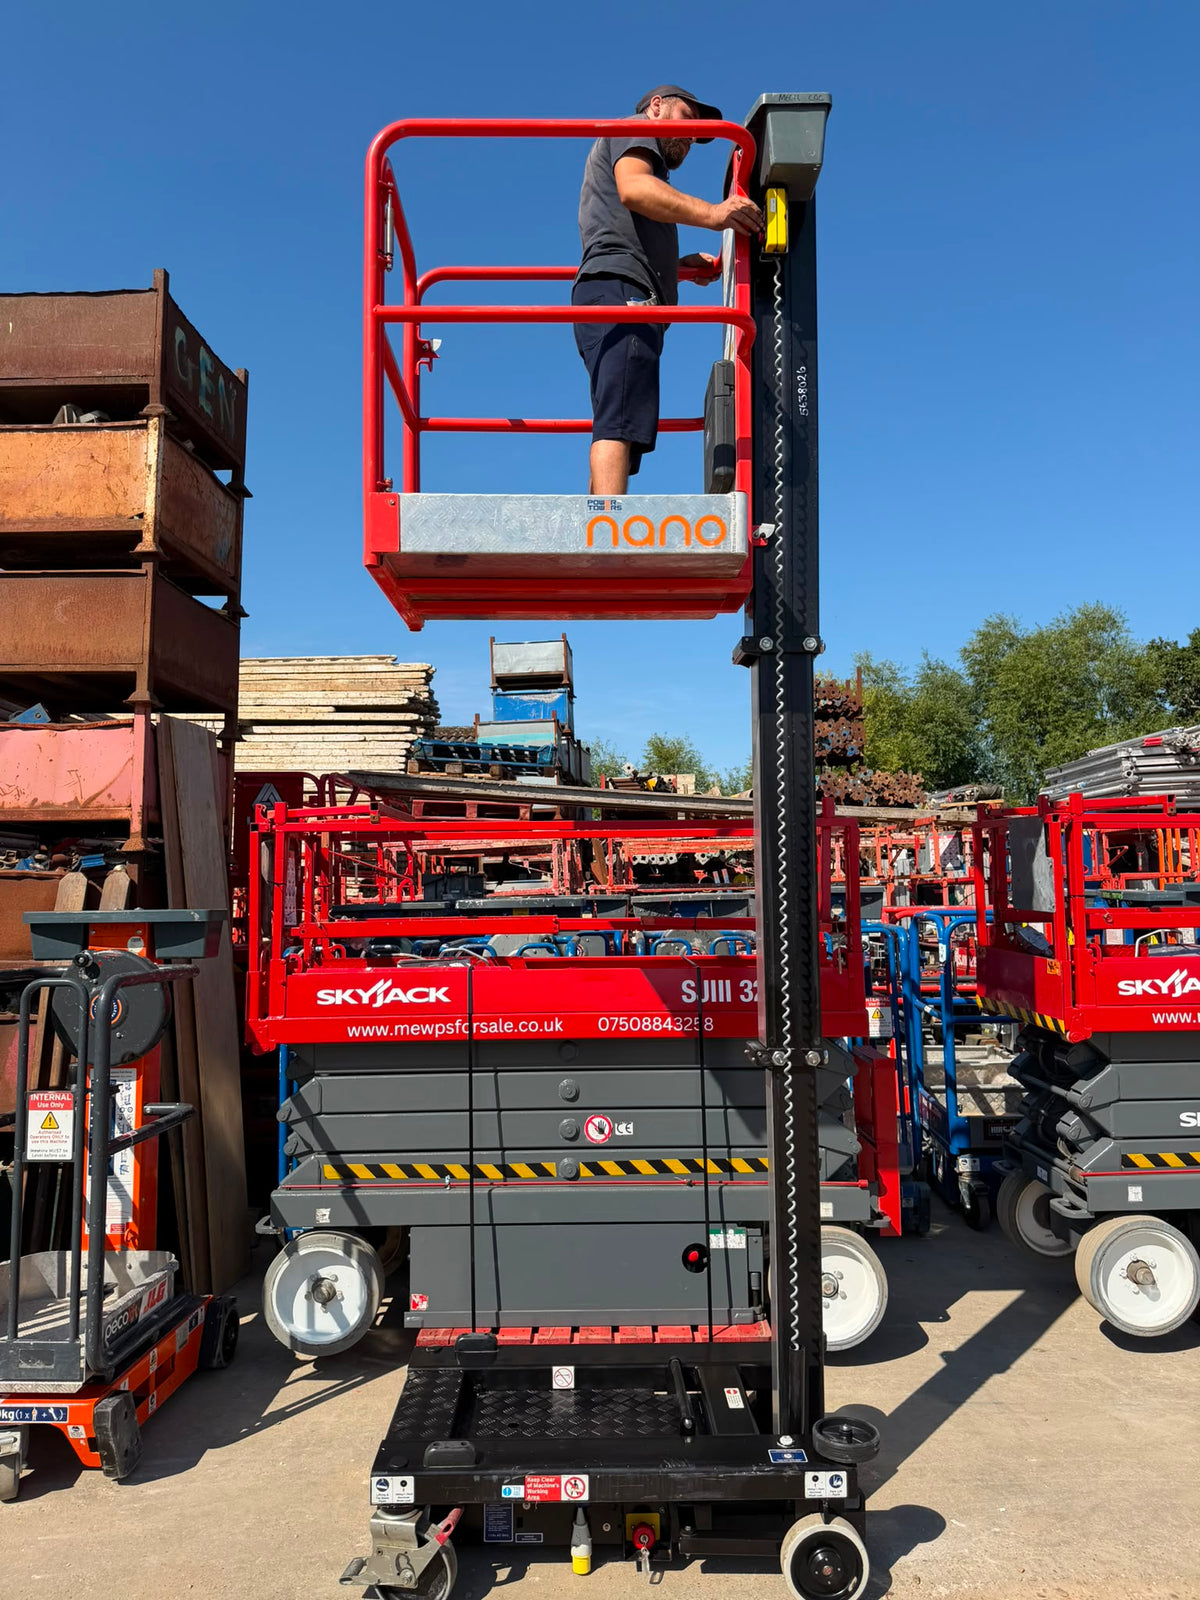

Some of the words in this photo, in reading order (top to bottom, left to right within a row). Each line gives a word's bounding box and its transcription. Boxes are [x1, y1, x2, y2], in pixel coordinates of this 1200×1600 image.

[586, 514, 727, 547] nano
[316, 979, 451, 1008] SKYJACK
[598, 1017, 714, 1031] 07508843258
[1151, 1012, 1200, 1024] www.
[347, 1017, 563, 1038] www.mewpsforsale.co.uk
[30, 1093, 72, 1101] INTERNAL
[1179, 1112, 1200, 1127] S
[143, 1280, 166, 1314] JLG
[0, 1409, 22, 1421] kg(1
